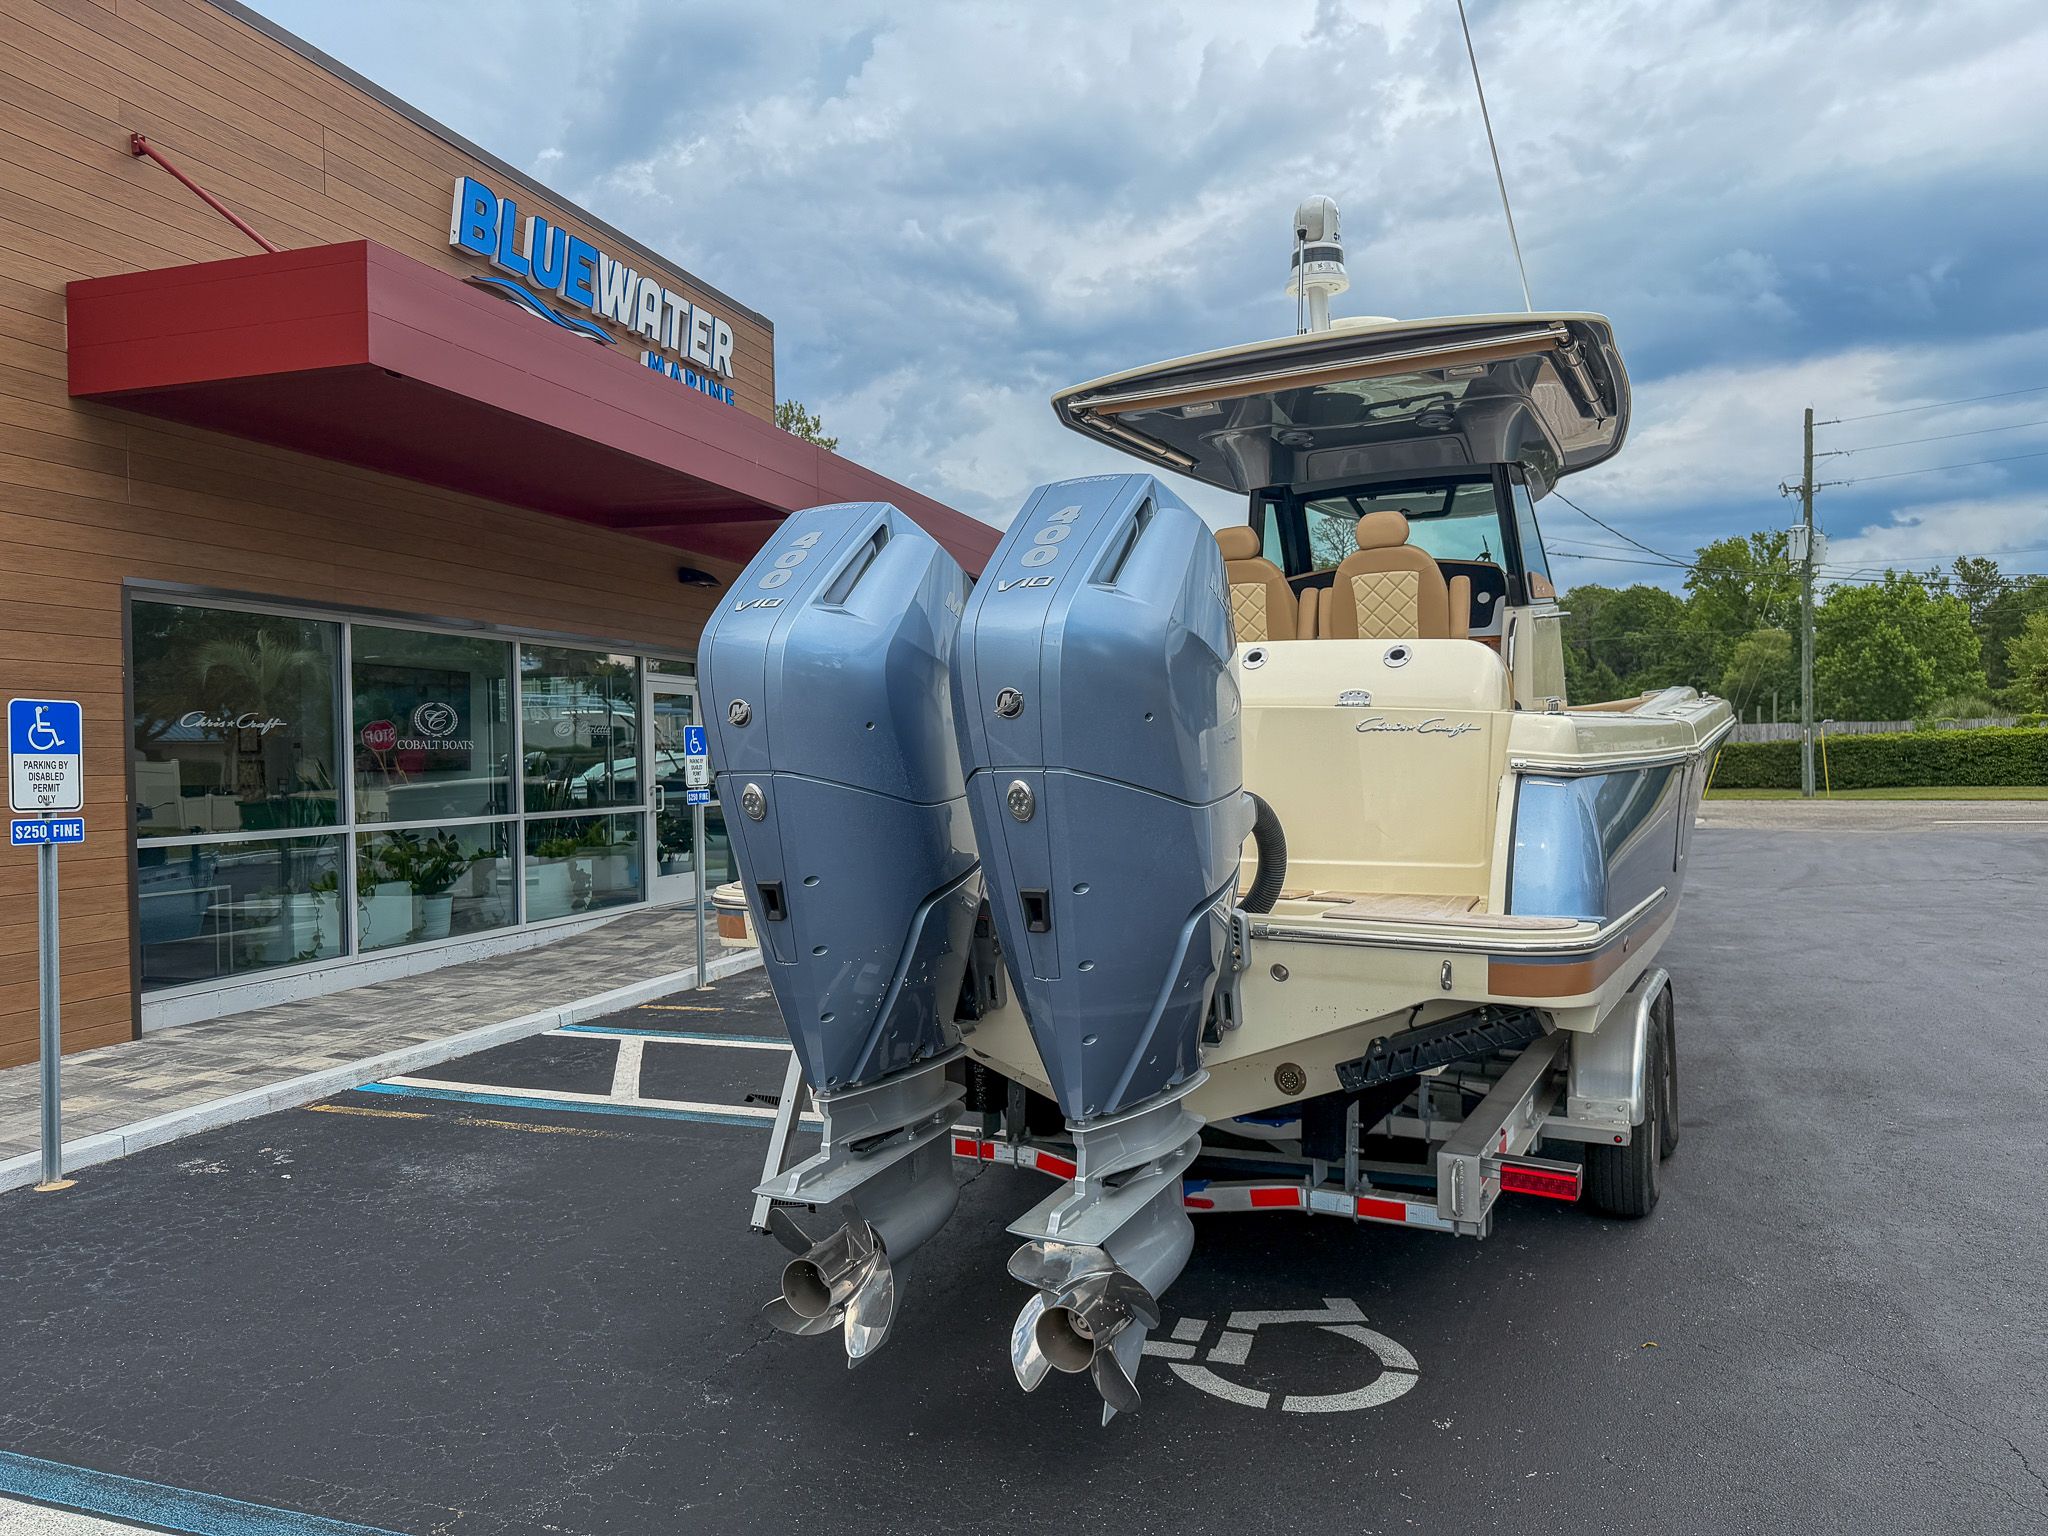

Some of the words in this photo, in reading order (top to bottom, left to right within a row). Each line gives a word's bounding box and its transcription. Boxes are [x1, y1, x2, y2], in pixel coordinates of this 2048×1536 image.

[1021, 504, 1083, 568] 400
[758, 530, 824, 590] 400
[998, 575, 1055, 592] V10
[734, 597, 785, 612] V10
[396, 739, 440, 751] COBALT
[442, 739, 475, 751] BOATS
[23, 760, 57, 770] PARKING
[58, 760, 69, 770] BY
[28, 772, 65, 781] DISABLED
[32, 783, 61, 793] PERMIT
[37, 794, 56, 804] ONLY
[15, 825, 48, 840] $250
[53, 823, 81, 838] FINE
